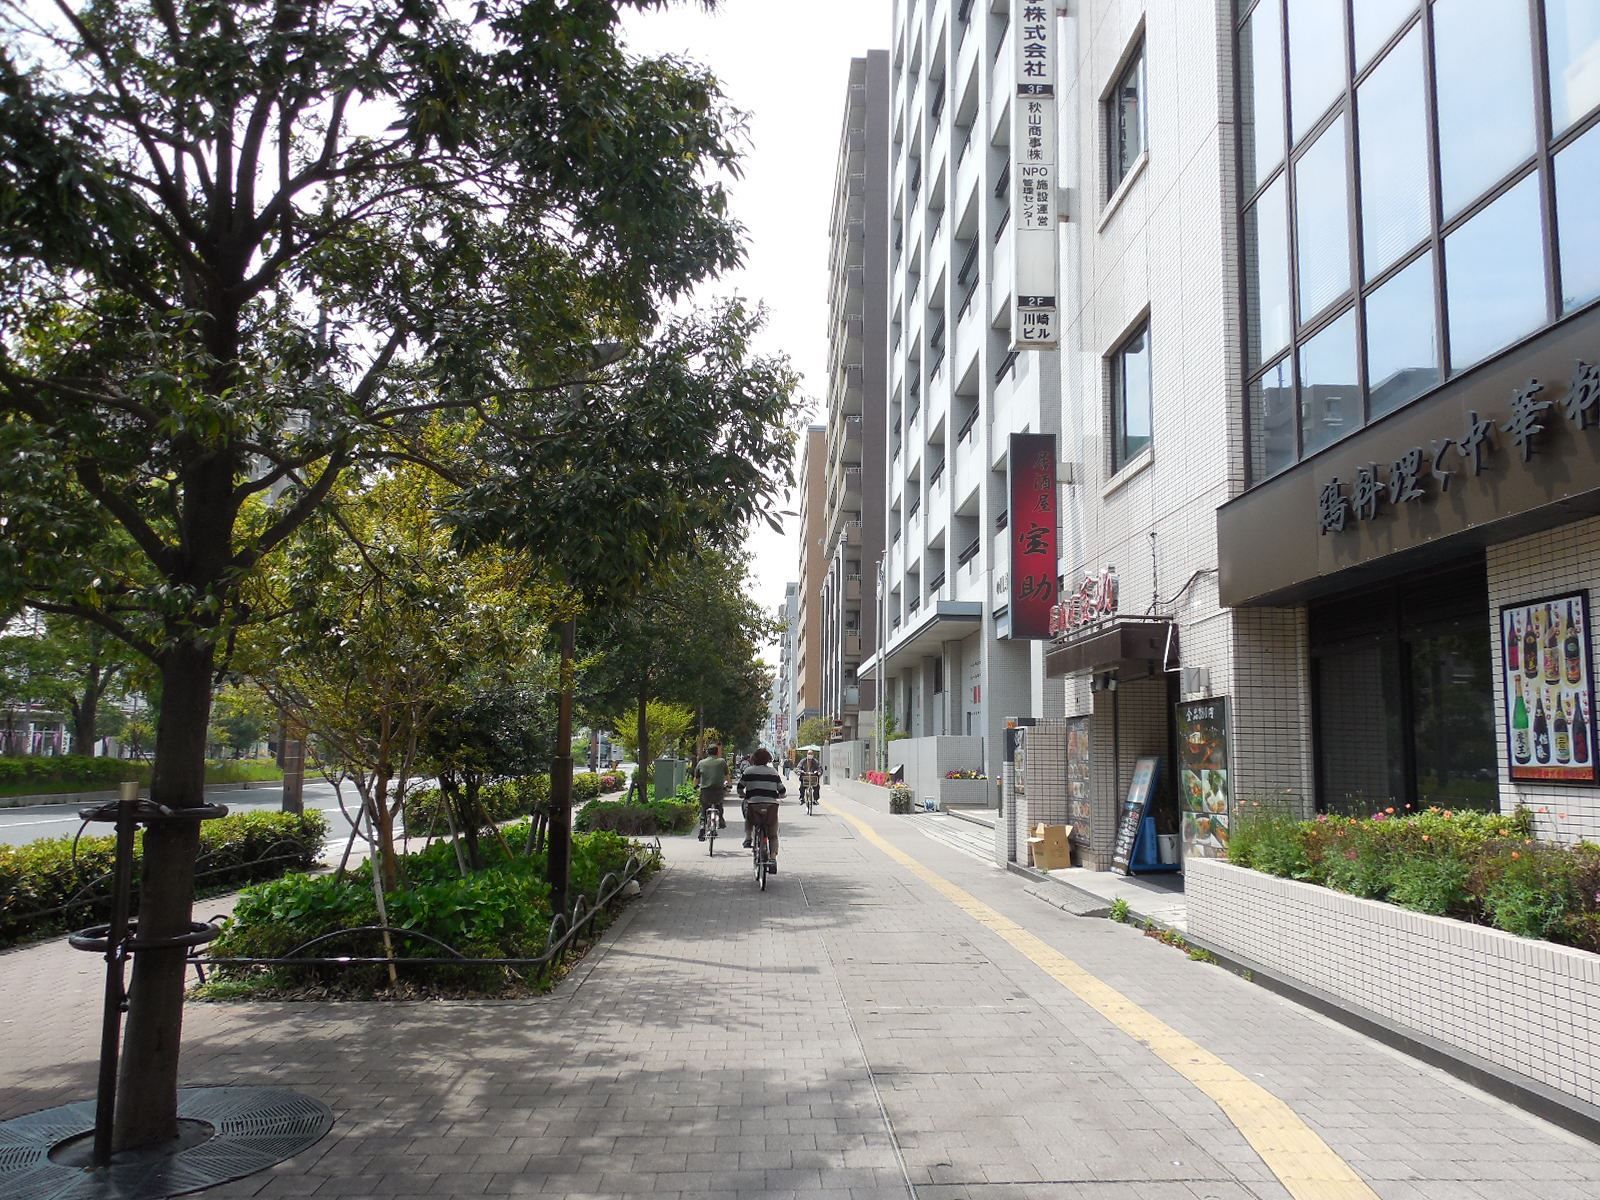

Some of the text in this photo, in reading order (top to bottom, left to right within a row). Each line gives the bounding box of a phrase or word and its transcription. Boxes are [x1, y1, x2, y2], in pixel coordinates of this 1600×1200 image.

[1023, 0, 1047, 76] 株式会社
[1027, 84, 1043, 94] 3F
[1022, 167, 1048, 177] NPO
[1022, 179, 1034, 227] 管理センター
[1036, 179, 1049, 227] 施設運営
[1028, 297, 1044, 306] 2F
[1023, 327, 1050, 340] ビル
